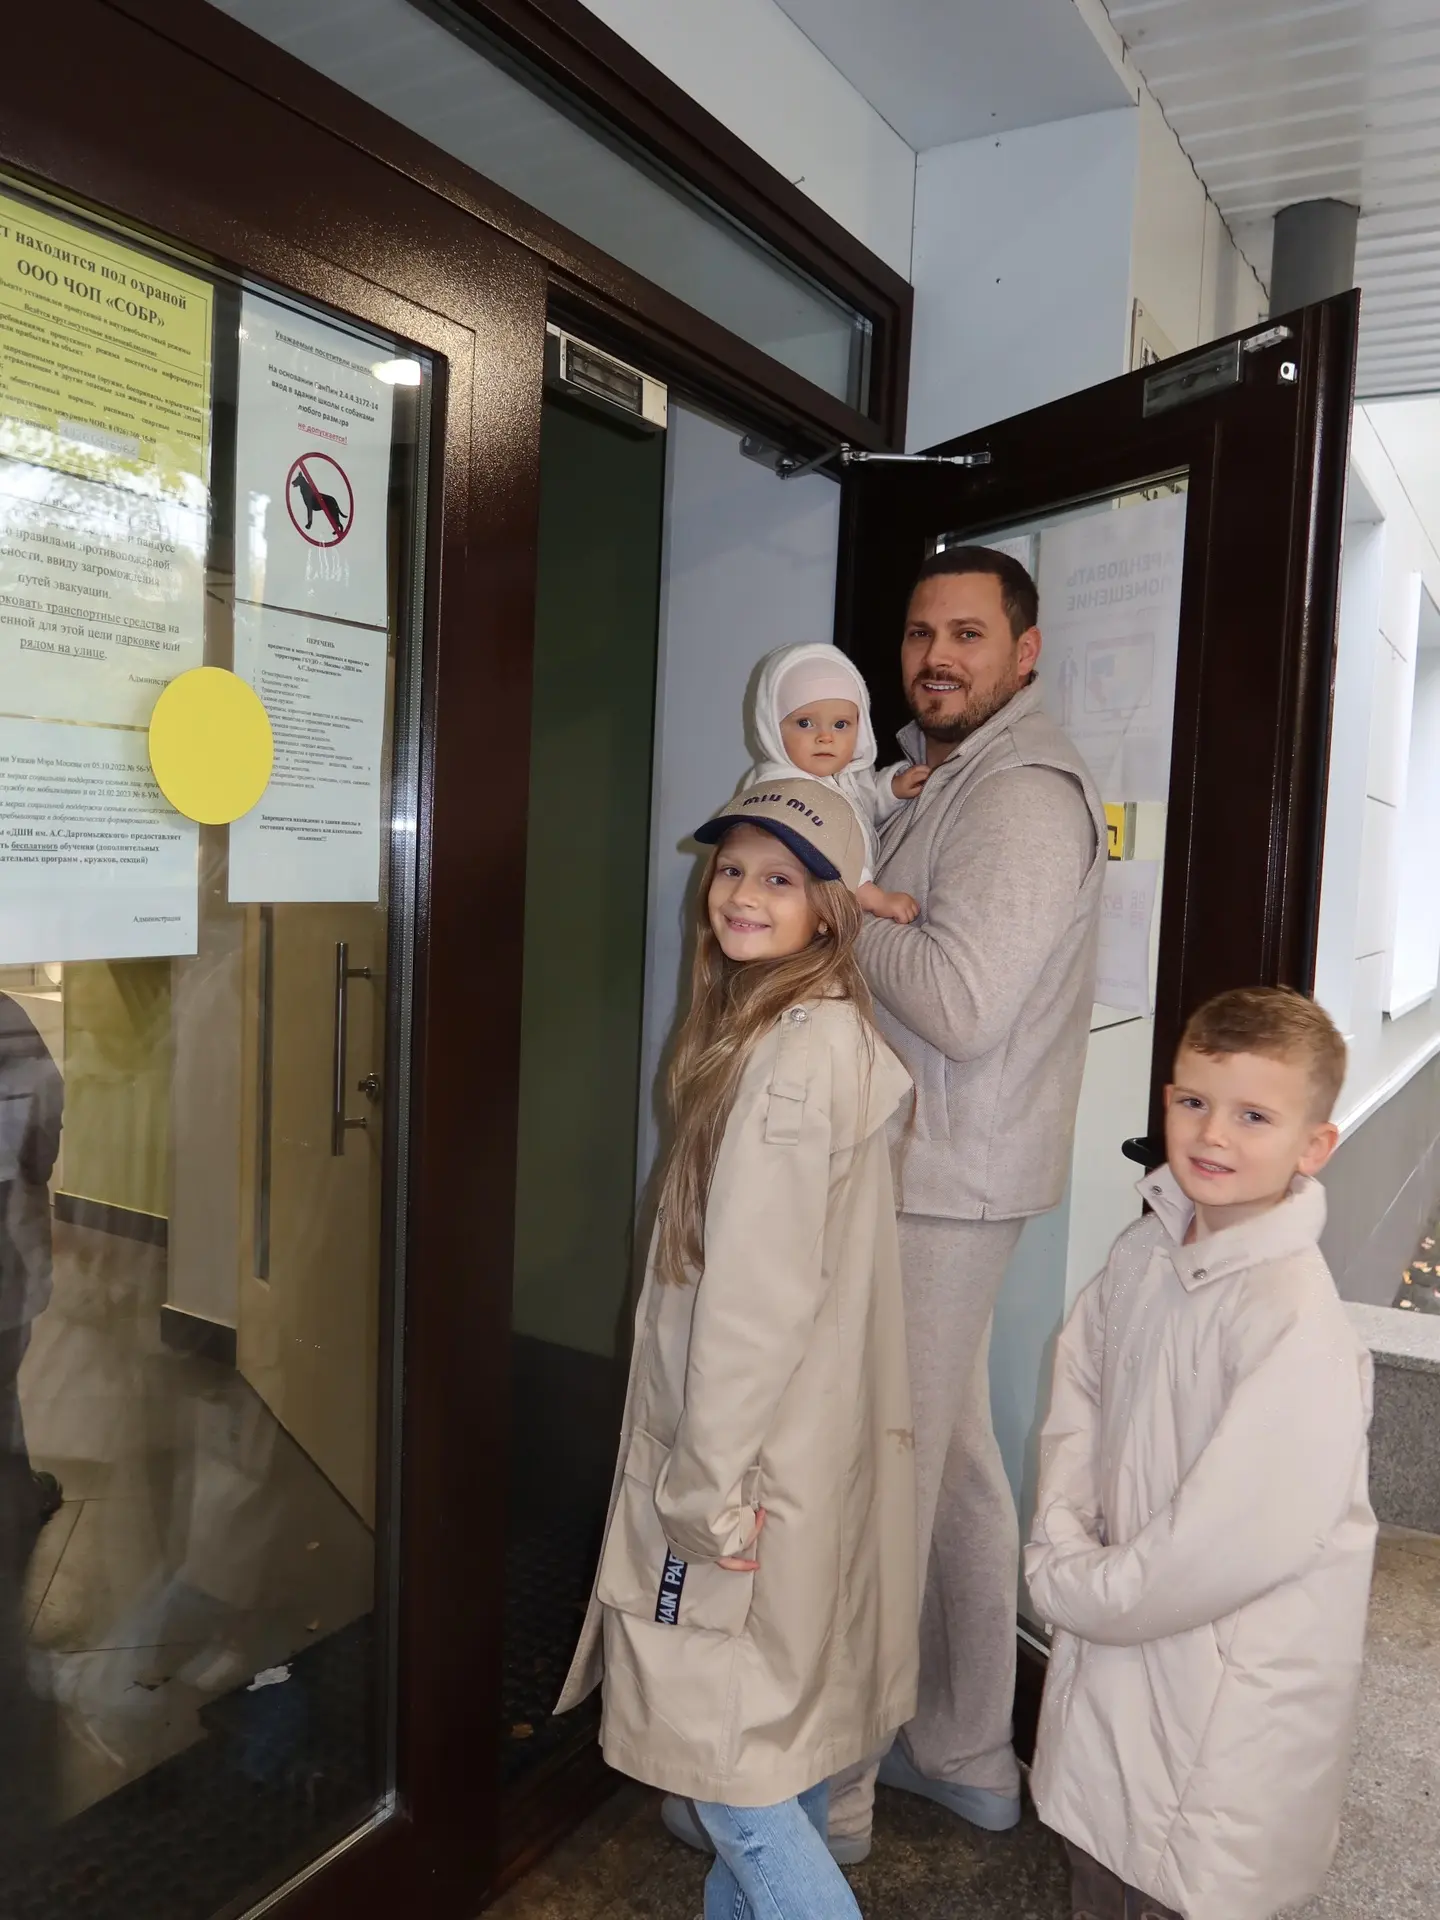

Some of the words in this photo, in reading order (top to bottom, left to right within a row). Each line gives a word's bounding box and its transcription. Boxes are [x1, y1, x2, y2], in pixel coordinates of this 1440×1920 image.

[15, 230, 96, 273] находится
[100, 265, 127, 287] под
[130, 278, 187, 310] охраной
[17, 259, 58, 286] ООО
[63, 275, 102, 304] ЧОП
[106, 296, 165, 328] «СОБР»
[275, 330, 314, 352] Уважаемые
[268, 364, 277, 374] На
[272, 380, 288, 392] вход
[318, 398, 340, 411] школы
[346, 407, 375, 422] собаками
[298, 404, 322, 418] любого
[46, 554, 79, 572] ввиду
[18, 573, 51, 587] путей
[46, 602, 121, 624] транспортные
[124, 616, 166, 632] средства
[168, 624, 180, 634] на
[38, 621, 57, 632] для
[60, 624, 85, 636] этой
[88, 629, 112, 641] цели
[115, 632, 161, 650] парковке
[162, 642, 180, 652] или
[20, 637, 54, 652] рядом
[58, 643, 70, 655] на
[74, 646, 108, 660] улице.
